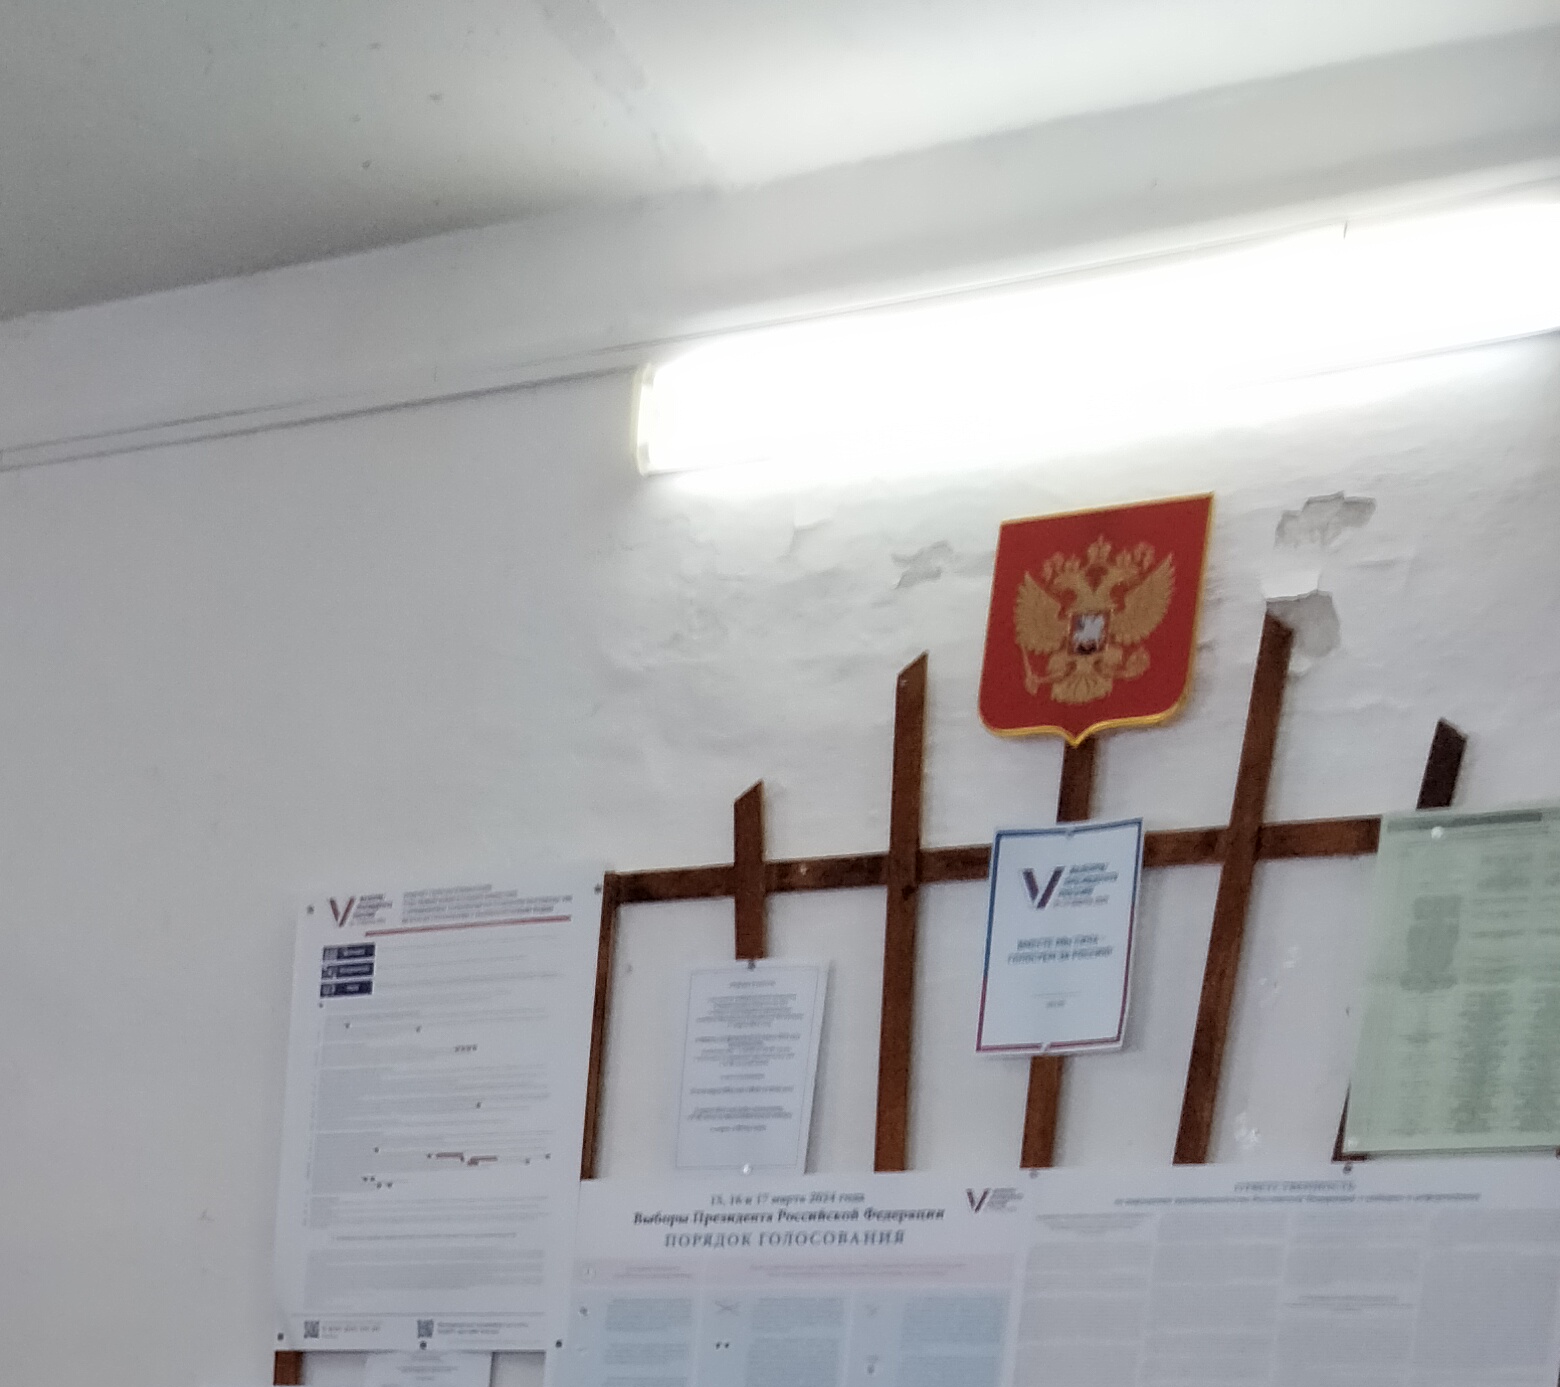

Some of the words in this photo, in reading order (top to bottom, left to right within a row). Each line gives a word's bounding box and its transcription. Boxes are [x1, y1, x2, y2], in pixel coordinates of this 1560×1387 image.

[634, 1210, 689, 1228] Выборы
[692, 1208, 773, 1228] Президента
[777, 1207, 859, 1223] Российской
[863, 1206, 945, 1225] Федерации
[664, 1231, 751, 1249] ПОРЯДОК
[758, 1229, 905, 1248] ГОЛОСОВАНИЯ
